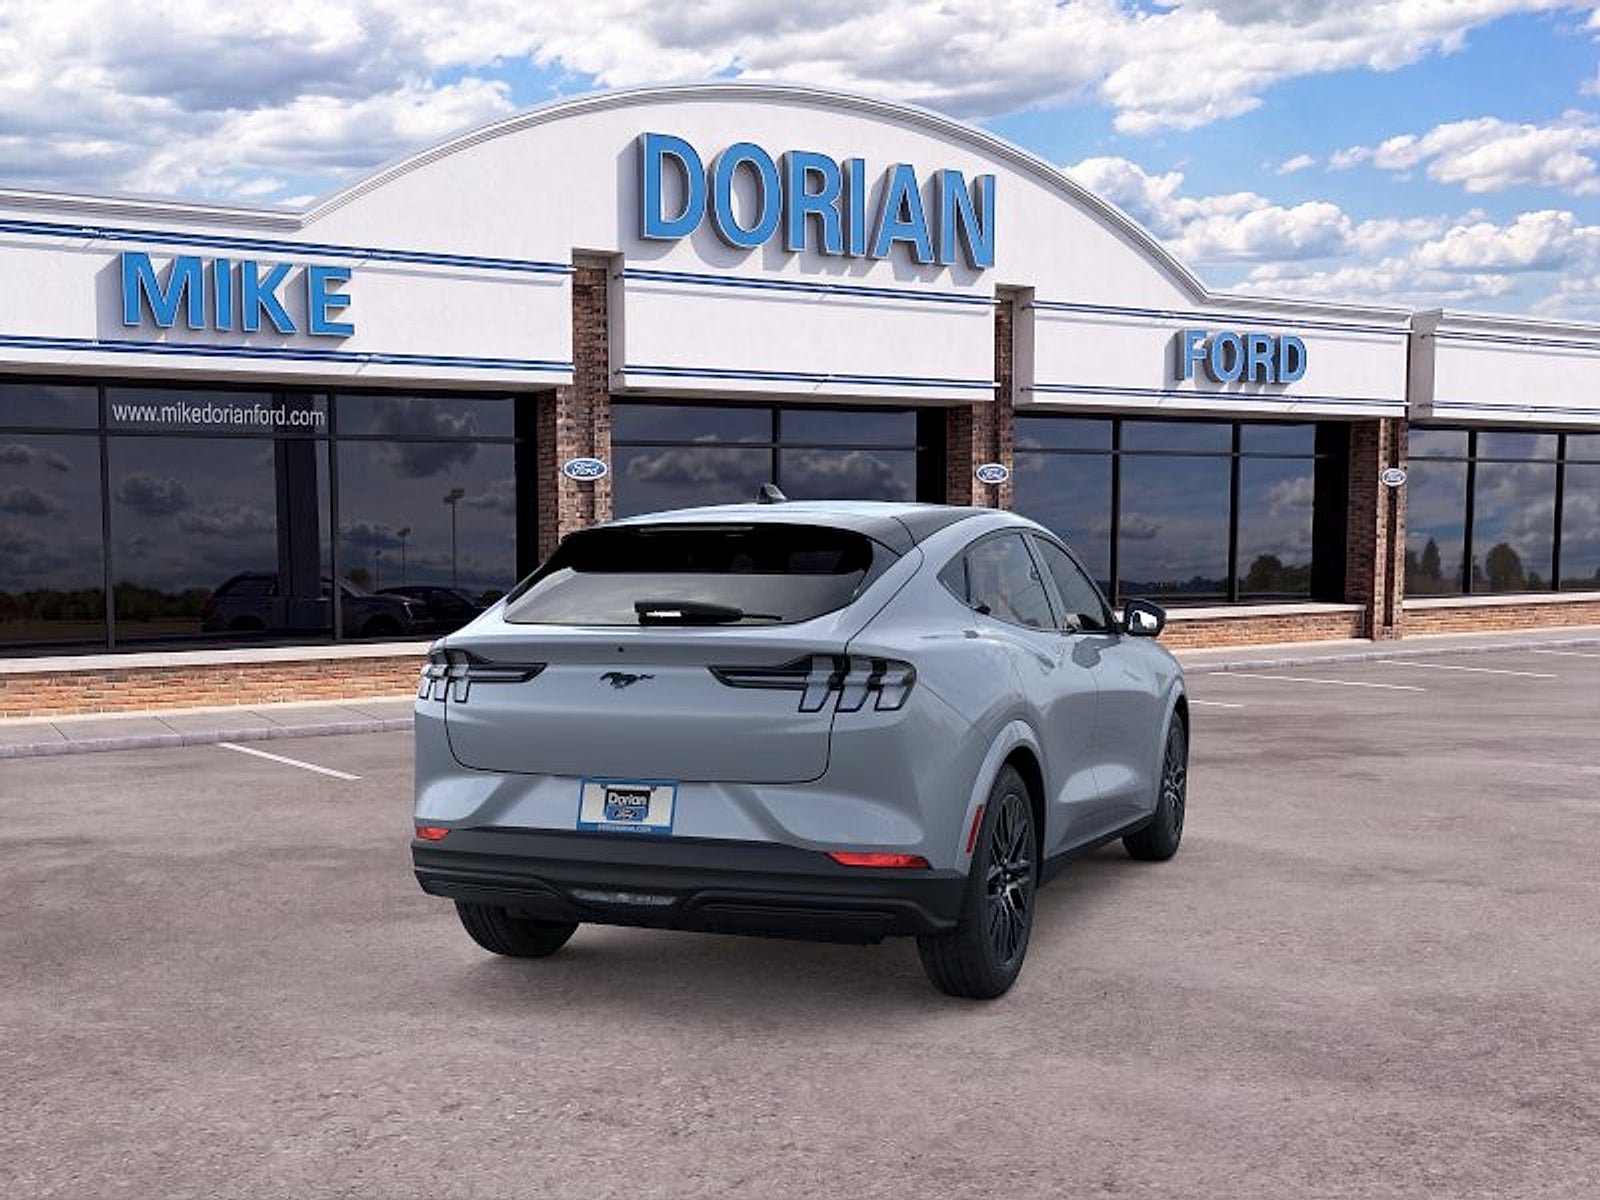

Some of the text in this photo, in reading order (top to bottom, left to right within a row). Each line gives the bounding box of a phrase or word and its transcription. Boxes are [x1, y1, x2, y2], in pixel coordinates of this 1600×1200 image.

[640, 132, 996, 270] DORIAN
[122, 251, 355, 337] MIKE
[1176, 328, 1308, 385] FORD
[112, 401, 325, 427] www.mikedorianford.com
[608, 792, 648, 805] Dorian
